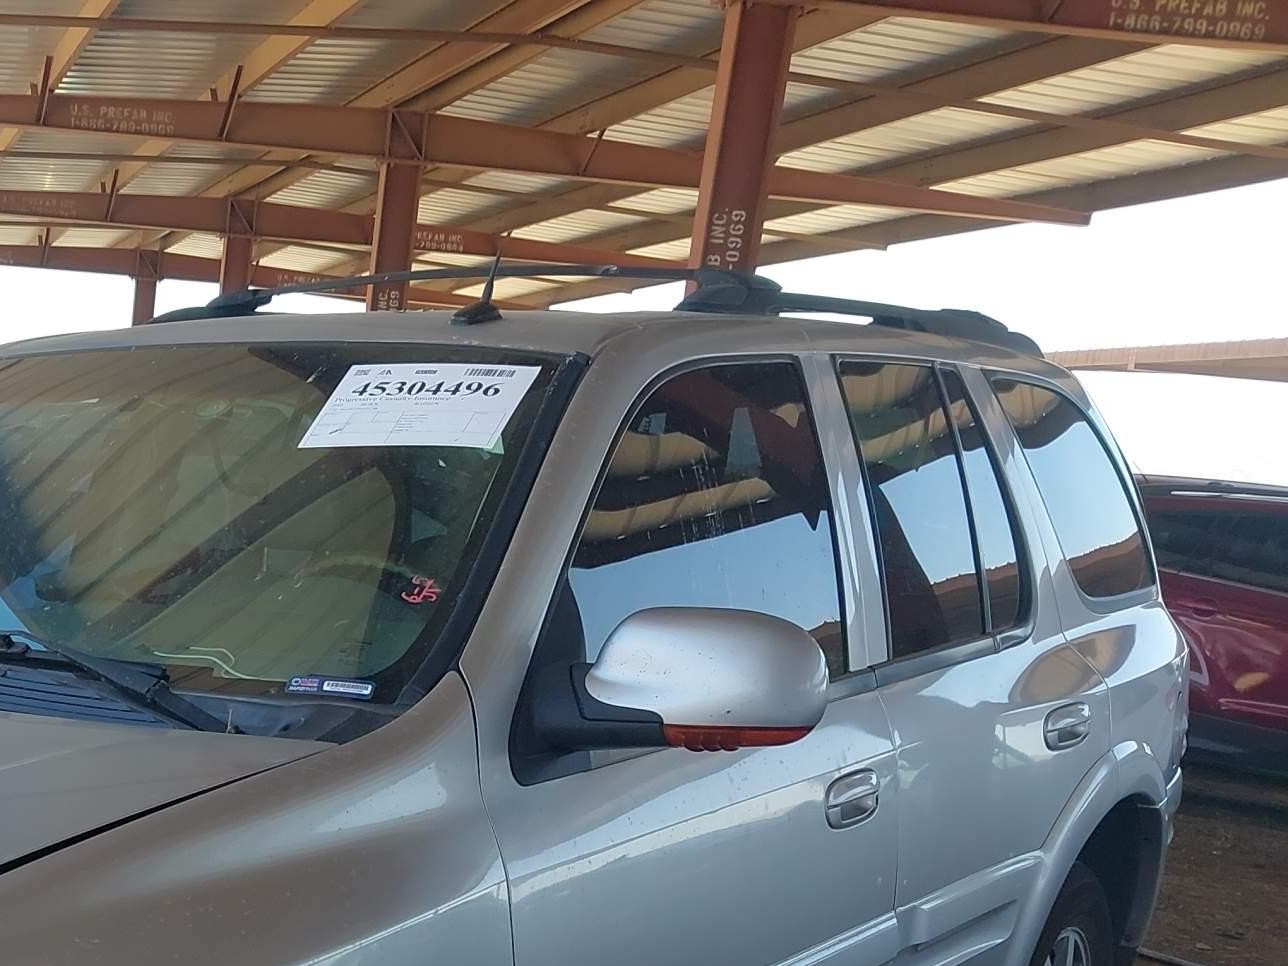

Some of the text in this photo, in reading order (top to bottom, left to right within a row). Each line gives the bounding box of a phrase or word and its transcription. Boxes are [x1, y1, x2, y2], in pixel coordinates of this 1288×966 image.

[1155, 0, 1228, 16] PREFAB
[1236, 1, 1270, 20] INC.
[1109, 12, 1266, 40] 1-866-799-0969
[710, 208, 729, 244] INC.
[352, 380, 505, 397] 45304496
